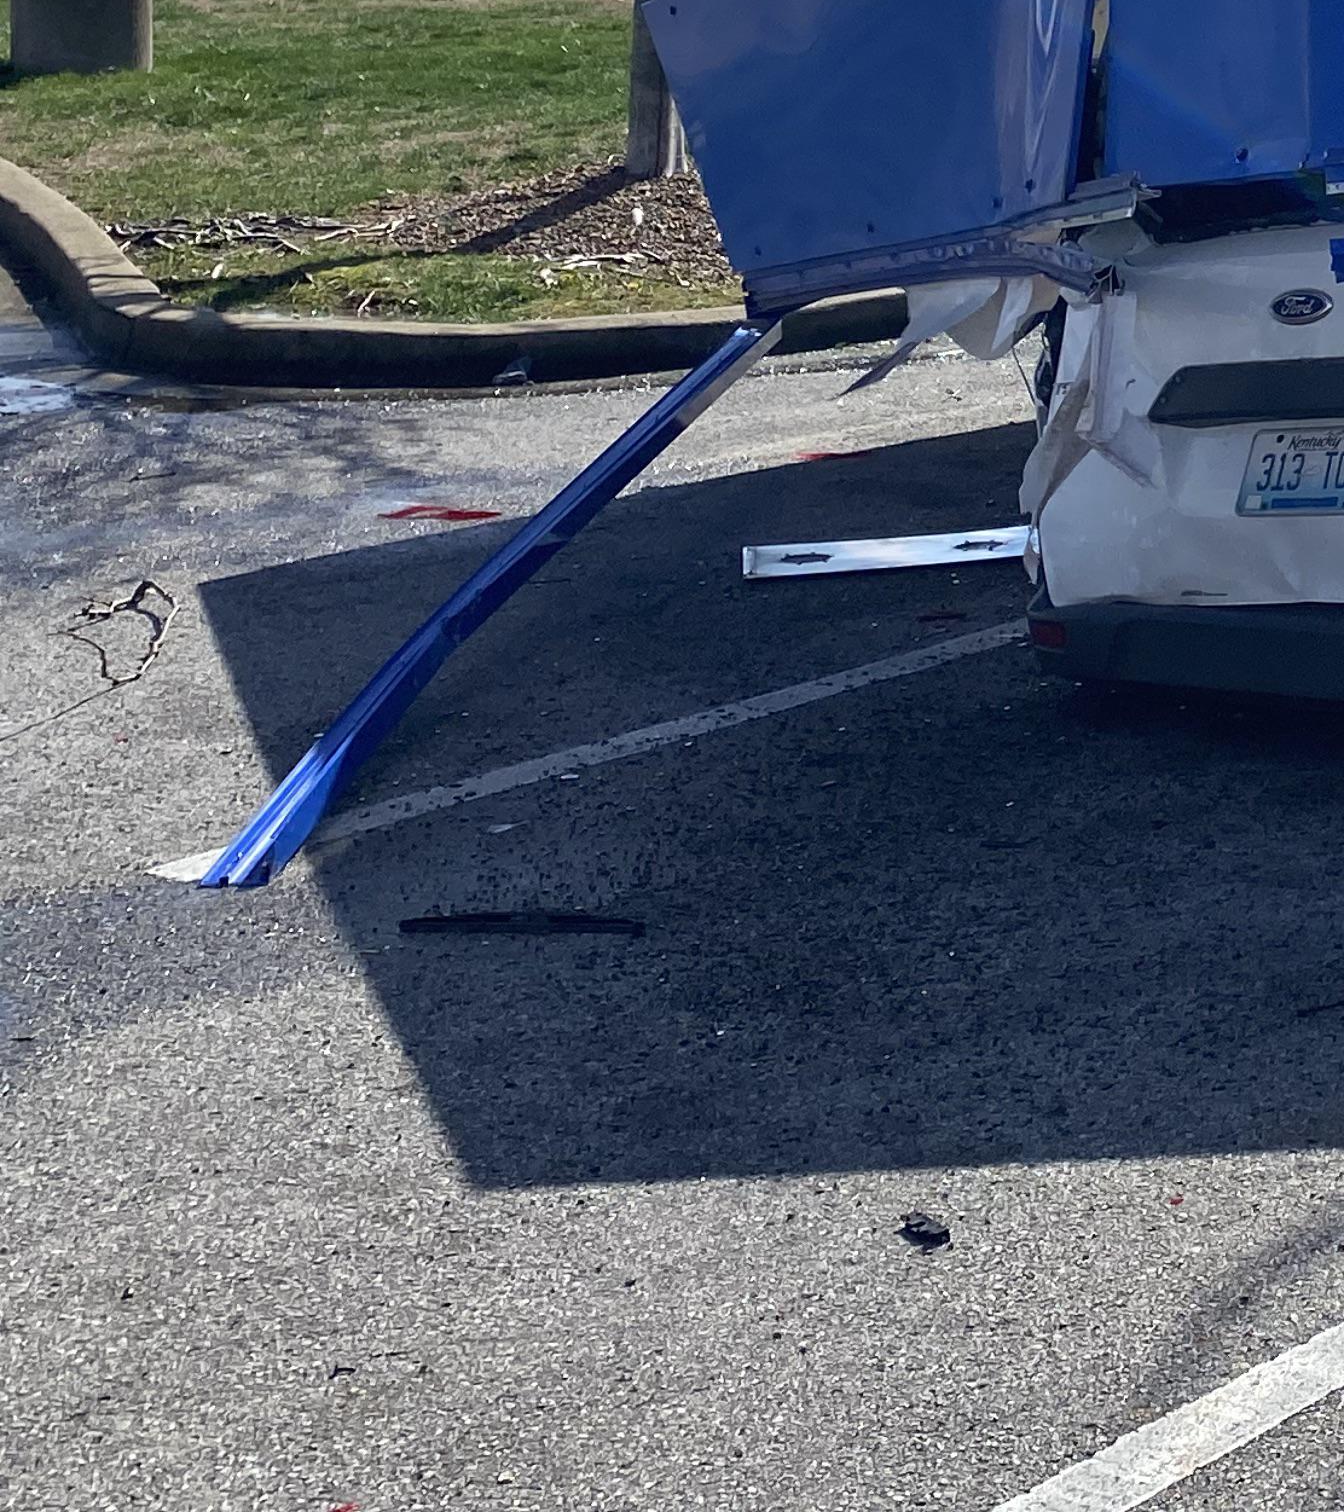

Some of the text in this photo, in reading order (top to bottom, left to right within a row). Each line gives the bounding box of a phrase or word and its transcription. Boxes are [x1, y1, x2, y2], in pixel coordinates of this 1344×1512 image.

[1280, 296, 1315, 315] Ford
[1287, 436, 1343, 451] Kentucky
[1256, 453, 1305, 491] 313
